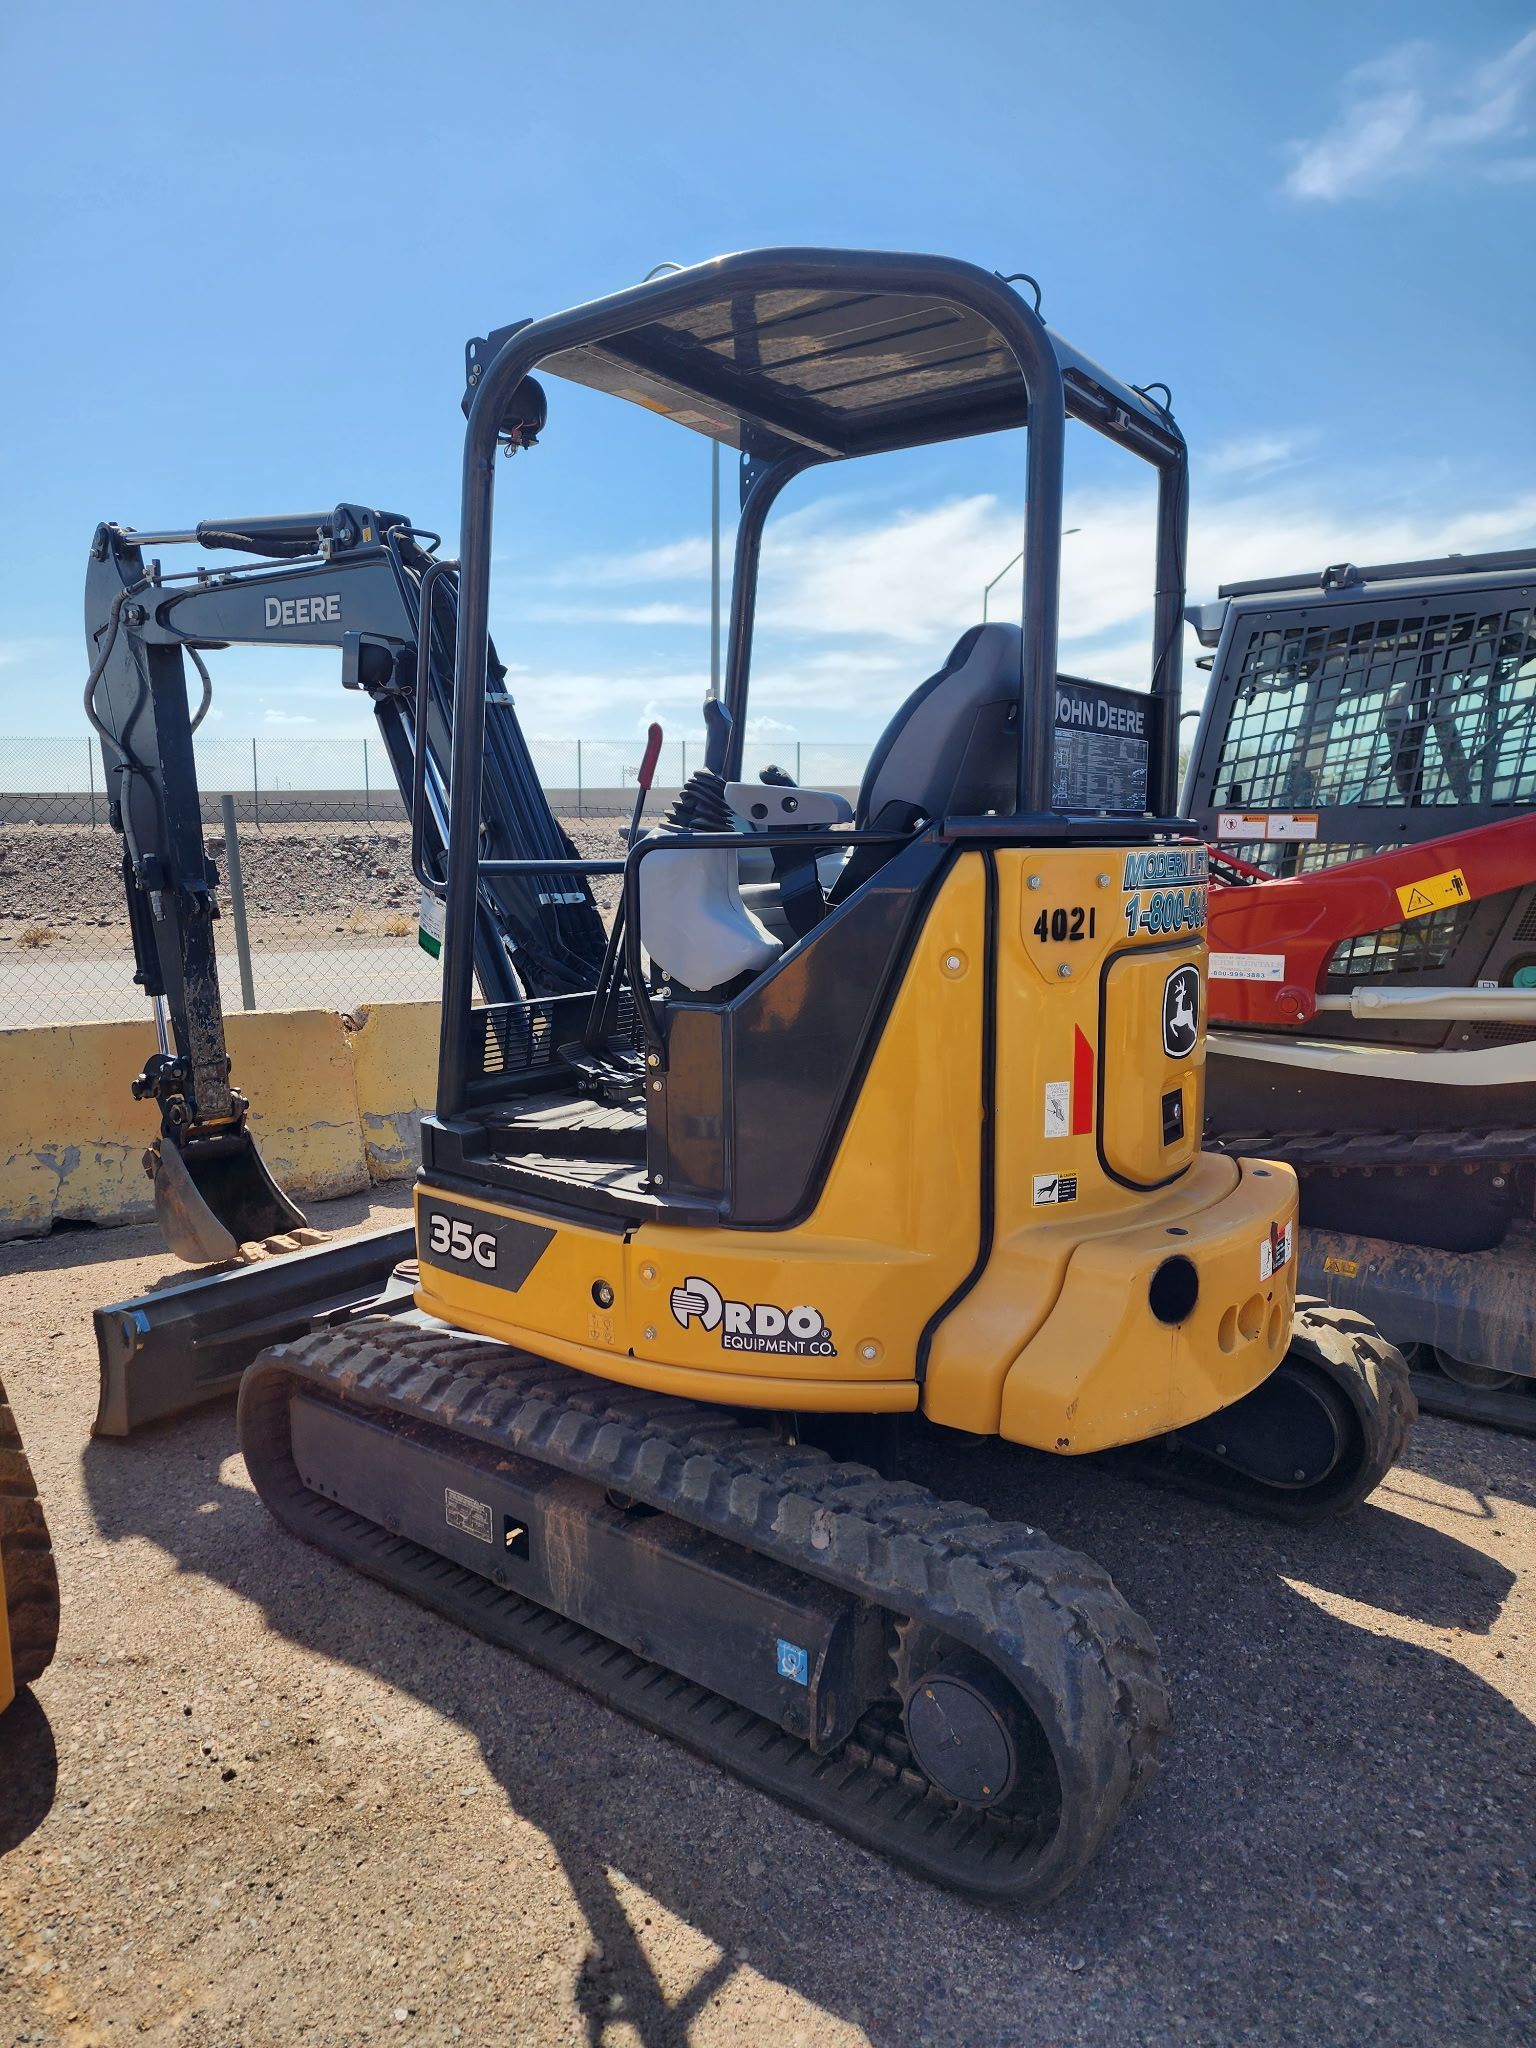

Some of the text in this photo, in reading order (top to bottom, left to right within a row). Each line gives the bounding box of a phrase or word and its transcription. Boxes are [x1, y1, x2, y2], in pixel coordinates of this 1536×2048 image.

[264, 594, 341, 627] DEERE
[1097, 699, 1145, 734] DEERE
[1034, 907, 1096, 942] 4021
[430, 1214, 497, 1269] 35G
[723, 1334, 836, 1355] EQUIPMENT CO.
